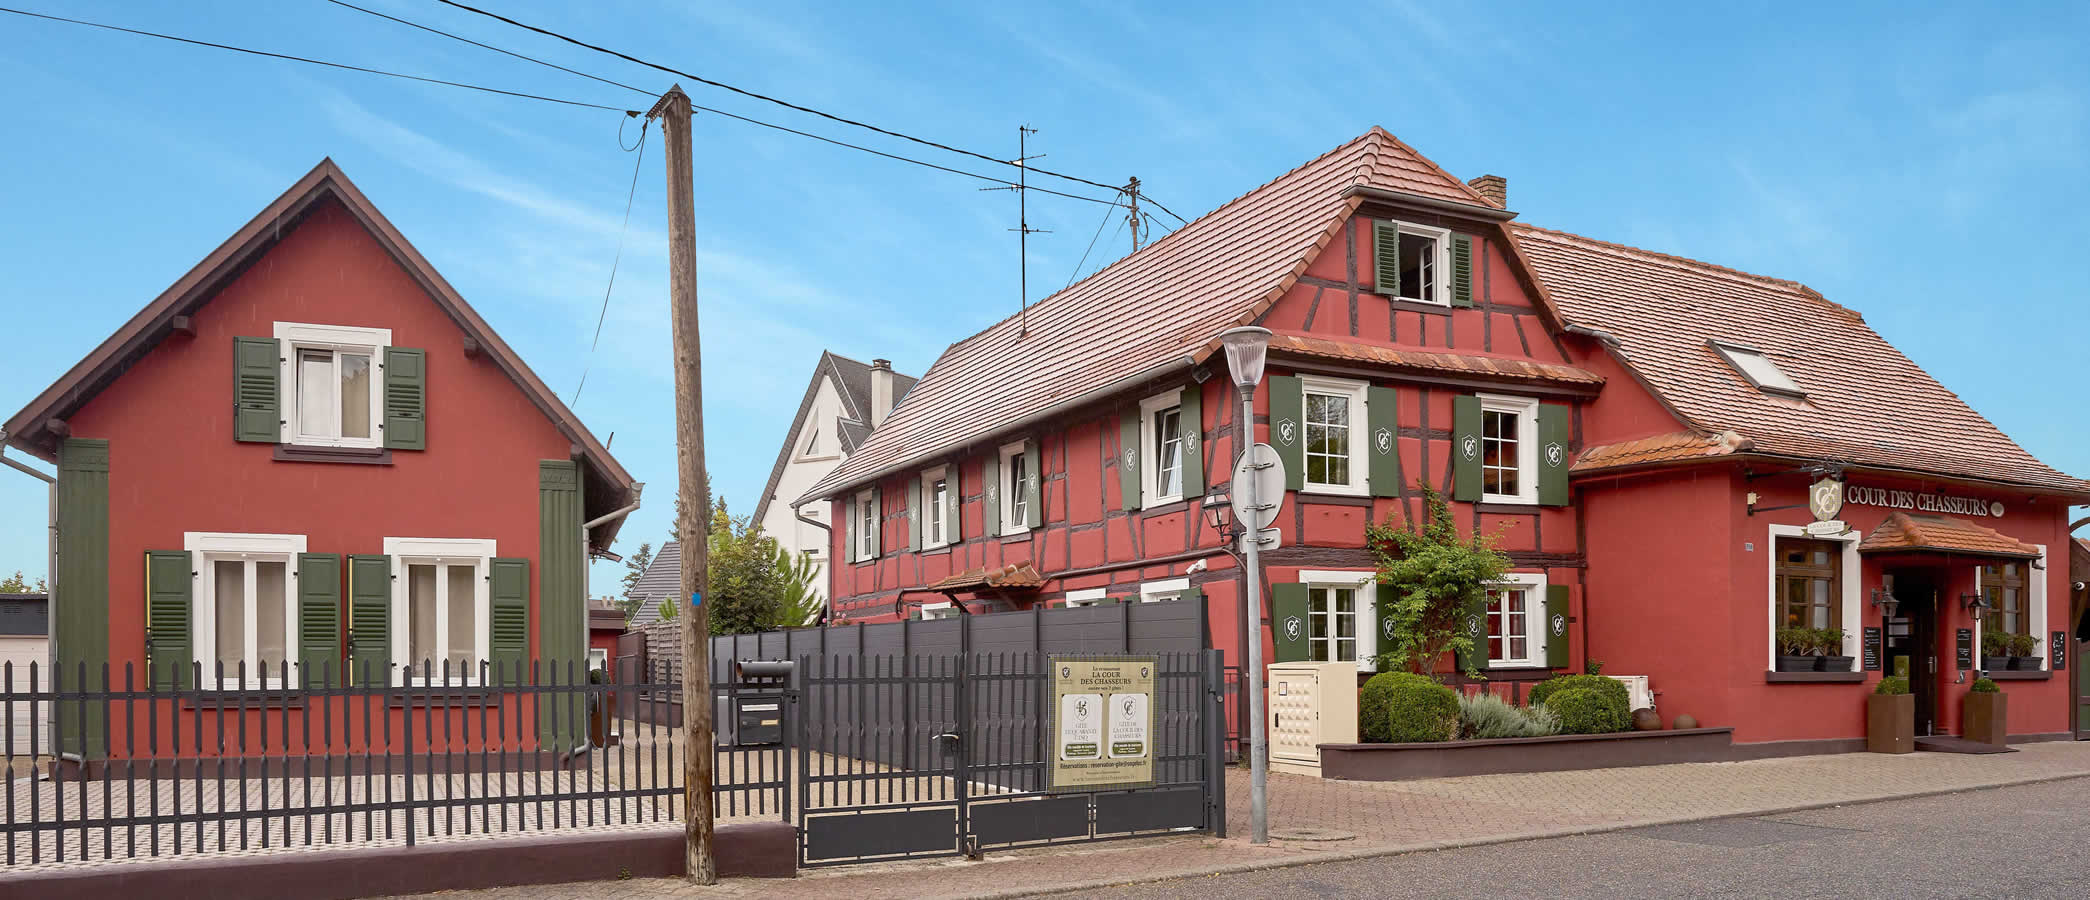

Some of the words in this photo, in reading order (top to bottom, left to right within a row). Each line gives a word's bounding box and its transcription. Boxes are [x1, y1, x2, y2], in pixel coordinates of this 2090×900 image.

[1848, 486, 1889, 507] COUR
[1890, 490, 1914, 510] DES
[1916, 493, 1988, 517] CHASSEURS
